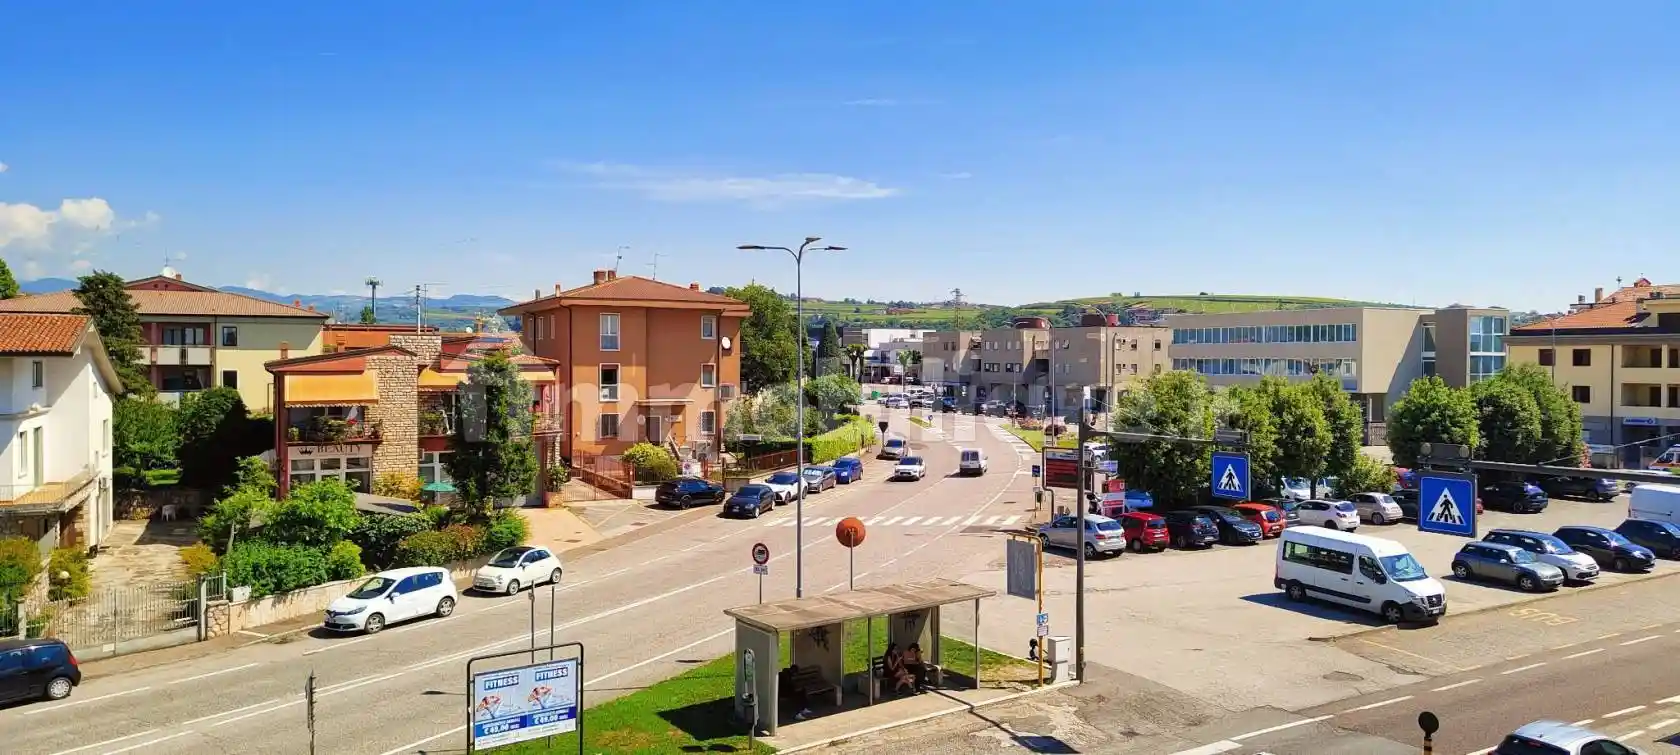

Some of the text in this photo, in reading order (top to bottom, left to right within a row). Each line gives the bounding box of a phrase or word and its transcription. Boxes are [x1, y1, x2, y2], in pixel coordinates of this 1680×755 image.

[317, 444, 361, 453] BEAUTY
[536, 668, 568, 681] FITNESS
[485, 676, 518, 689] FITNESS
